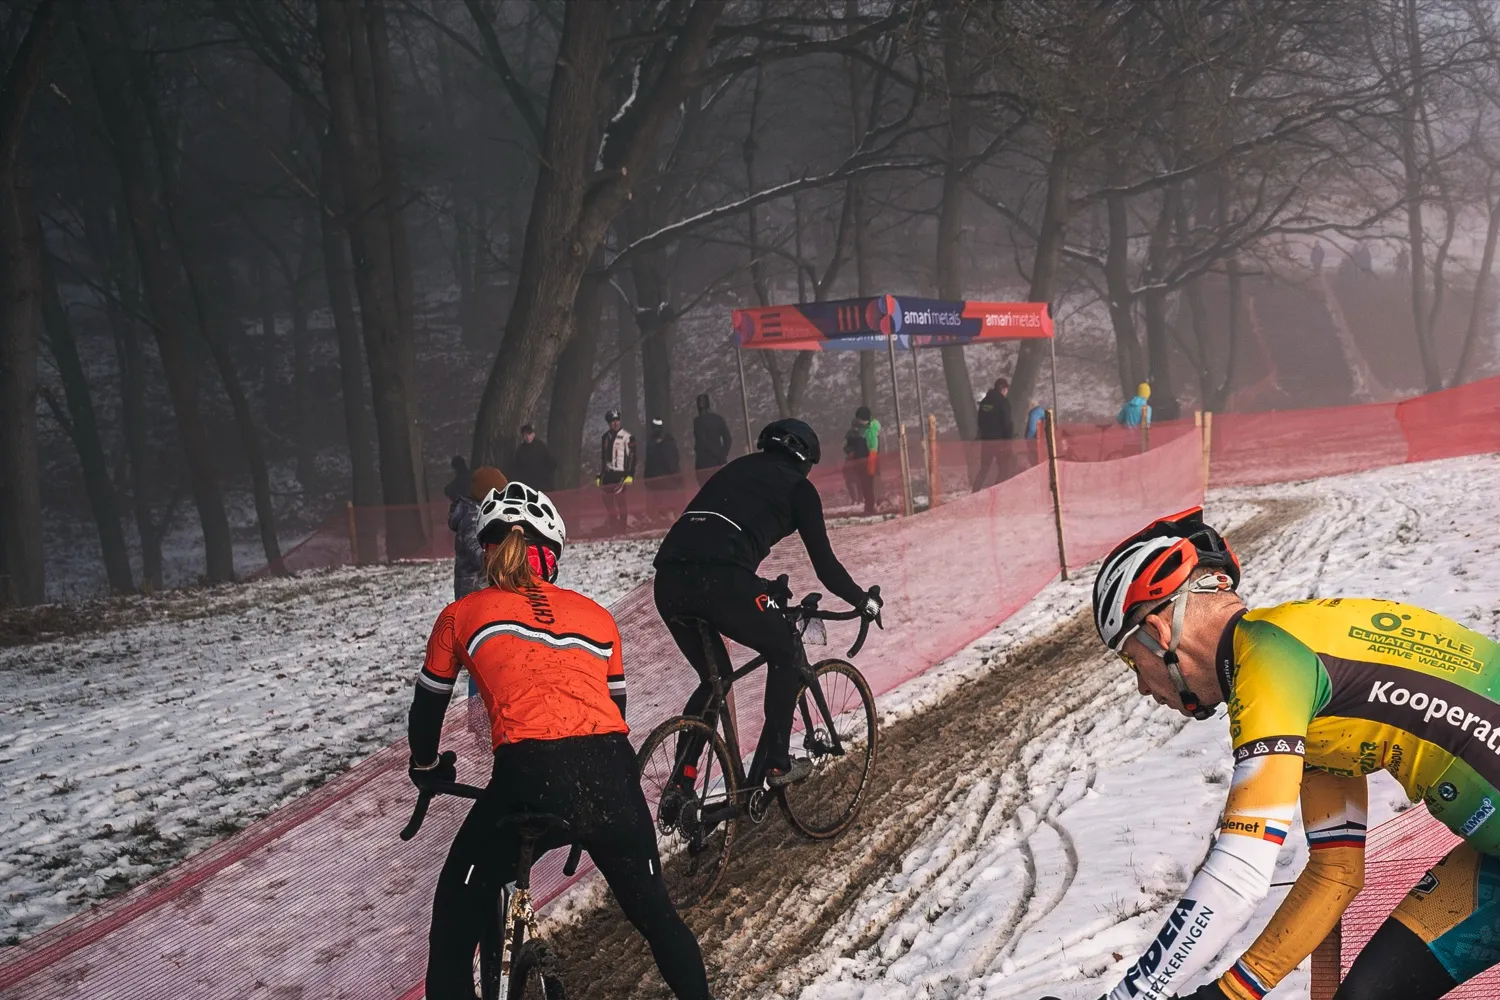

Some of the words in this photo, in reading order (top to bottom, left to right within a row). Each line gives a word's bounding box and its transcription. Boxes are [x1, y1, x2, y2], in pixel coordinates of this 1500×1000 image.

[1352, 629, 1412, 650] CLIMATE
[1413, 644, 1480, 671] CONTROL
[1367, 644, 1413, 660] ACTIVE
[1418, 655, 1457, 673] WEAR
